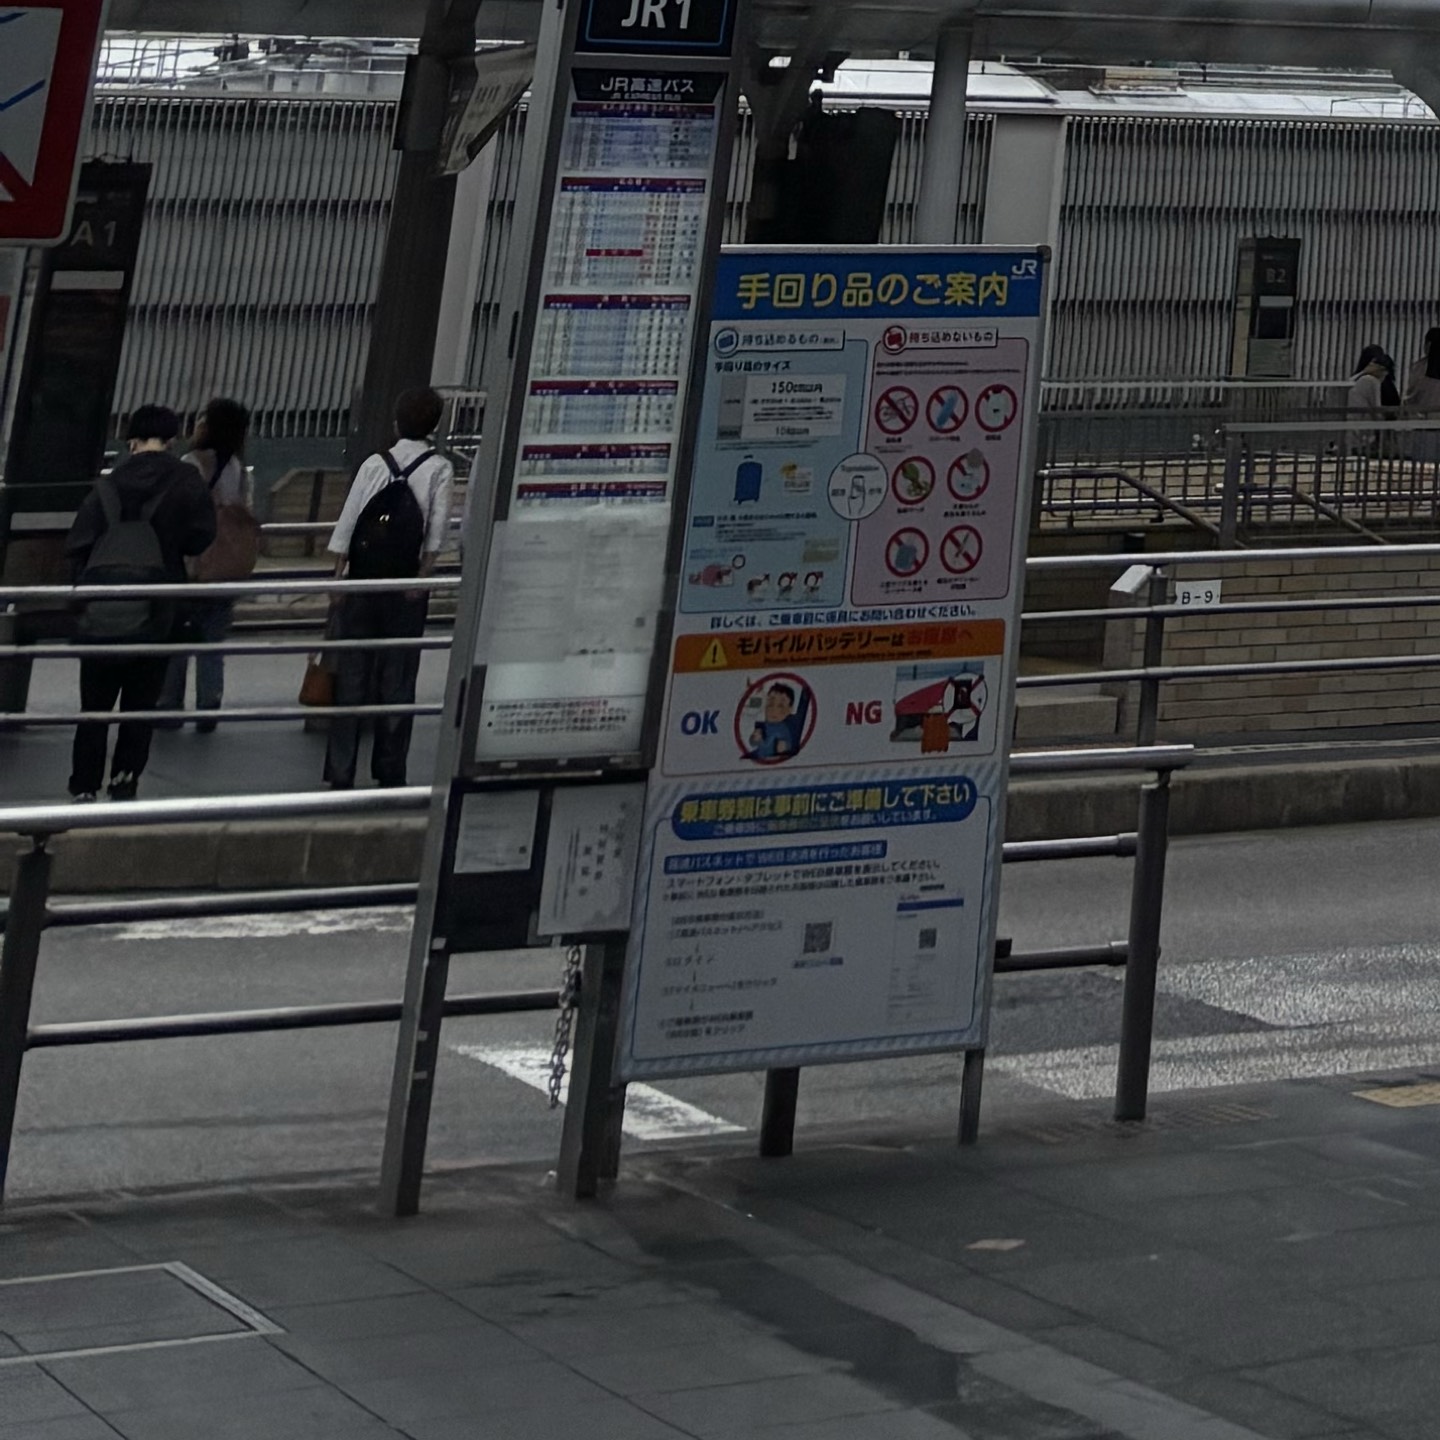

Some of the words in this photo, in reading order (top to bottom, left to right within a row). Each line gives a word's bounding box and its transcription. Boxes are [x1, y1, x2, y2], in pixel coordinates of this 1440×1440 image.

[1012, 259, 1038, 276] JR
[736, 270, 1009, 311] 手回り品のご案内
[909, 332, 993, 344] 持ち込めないもの
[681, 710, 720, 736] OK
[846, 700, 882, 725] NG
